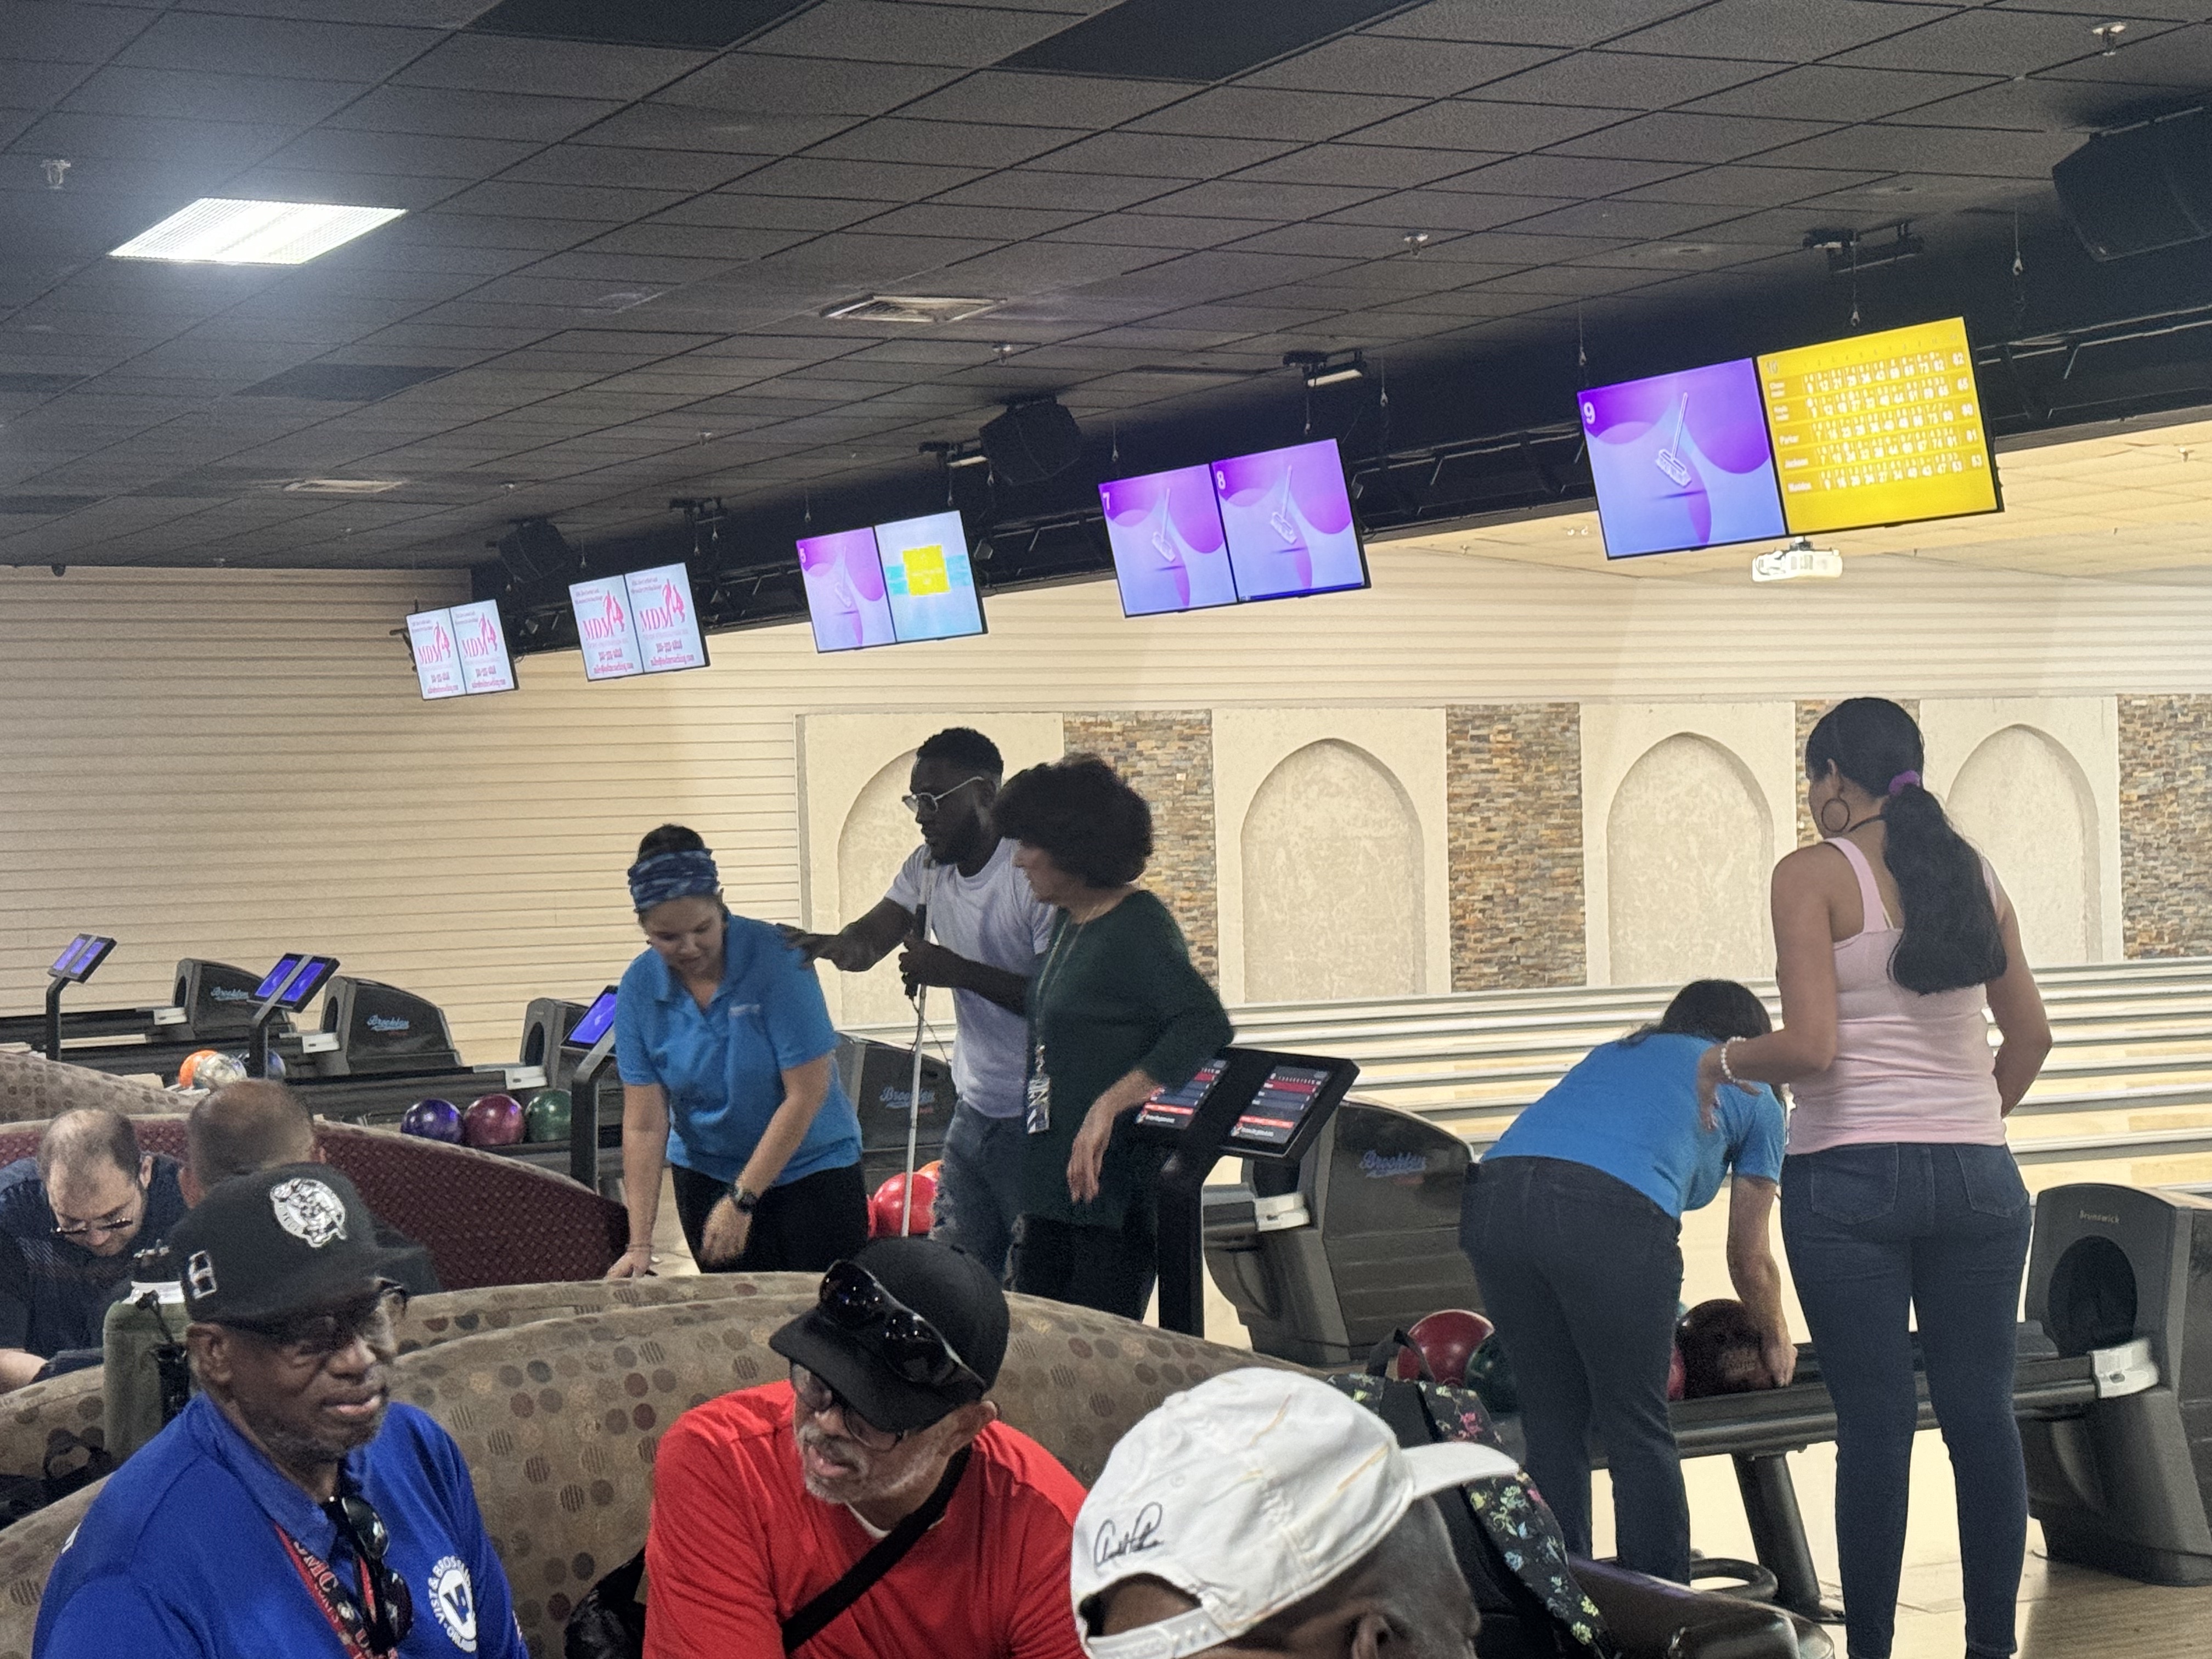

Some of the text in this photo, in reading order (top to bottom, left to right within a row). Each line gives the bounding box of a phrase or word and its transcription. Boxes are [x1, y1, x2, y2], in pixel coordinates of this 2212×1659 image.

[1953, 353, 1963, 365] 82
[1583, 402, 1595, 425] 9
[1966, 430, 1976, 441] 81
[1216, 471, 1226, 490] 8
[1103, 492, 1110, 510] 7
[799, 548, 806, 563] 5
[1359, 1149, 1427, 1178] Brooklyn
